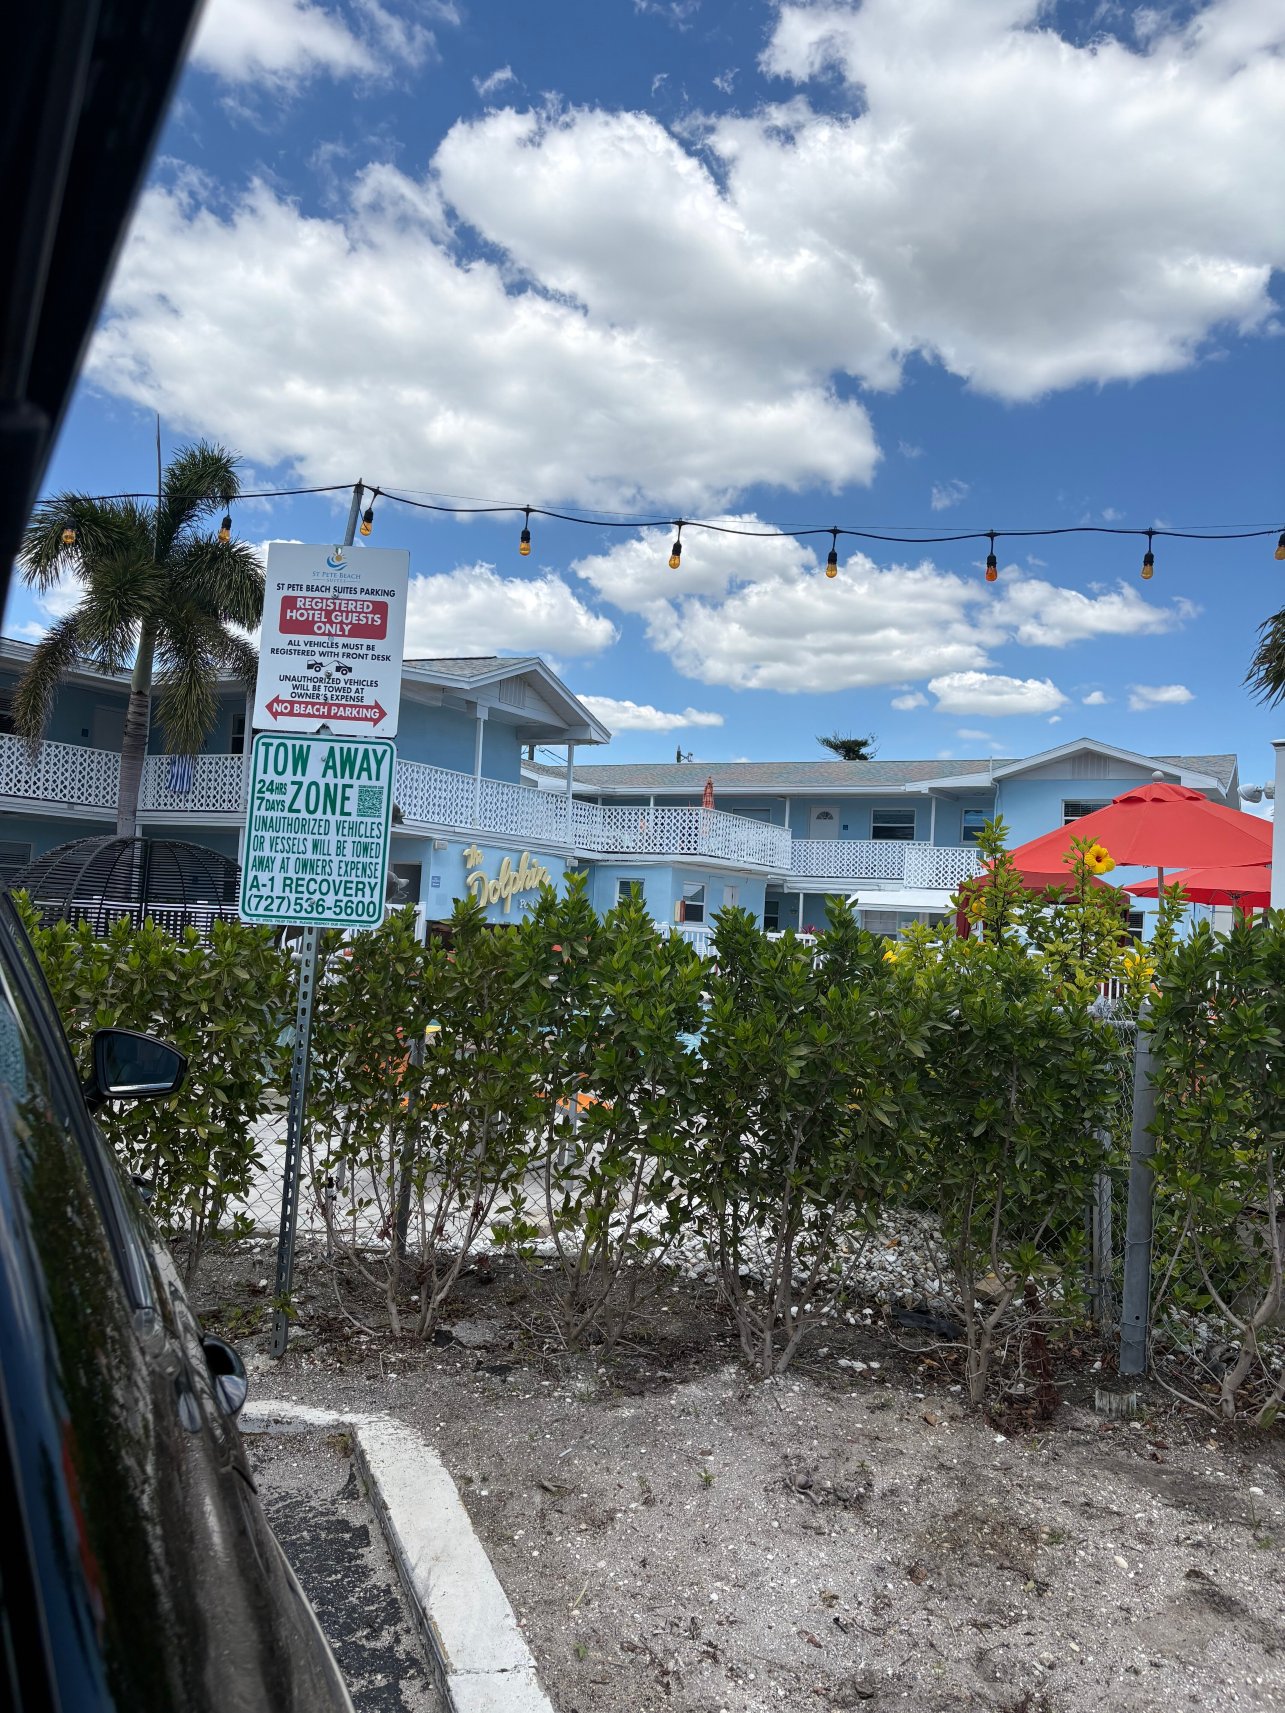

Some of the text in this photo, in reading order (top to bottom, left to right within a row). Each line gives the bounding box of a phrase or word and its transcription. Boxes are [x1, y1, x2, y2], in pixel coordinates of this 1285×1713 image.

[287, 584, 303, 592] PETE
[306, 584, 330, 593] BEACH
[333, 586, 358, 595] SUITES
[360, 587, 396, 597] PARKING
[296, 598, 373, 612] REGISTERED
[286, 609, 381, 625] HOTEL GUESTS
[314, 623, 352, 635] ONLY
[303, 640, 339, 649] VEHICLES
[270, 648, 316, 657] REGISTERED
[342, 652, 369, 660] FRONT
[278, 674, 379, 687] UNAUTHORIZED VEHICLES
[290, 692, 365, 703] OWNER'S EXPENSE
[324, 685, 352, 694] TOWED
[272, 703, 380, 719] NO BEACH PARKING
[261, 742, 388, 781] TOW AWAY
[288, 780, 354, 817] ZONE
[254, 815, 382, 839] UNAUTHORIZED VEHICLES
[252, 835, 381, 859] OR VESSELS WILL BE TOWED
[251, 855, 379, 879] AWAY AT OWNERS EXPENSE
[249, 875, 378, 898] A-1 RECOVERY
[466, 851, 551, 914] Dolphin
